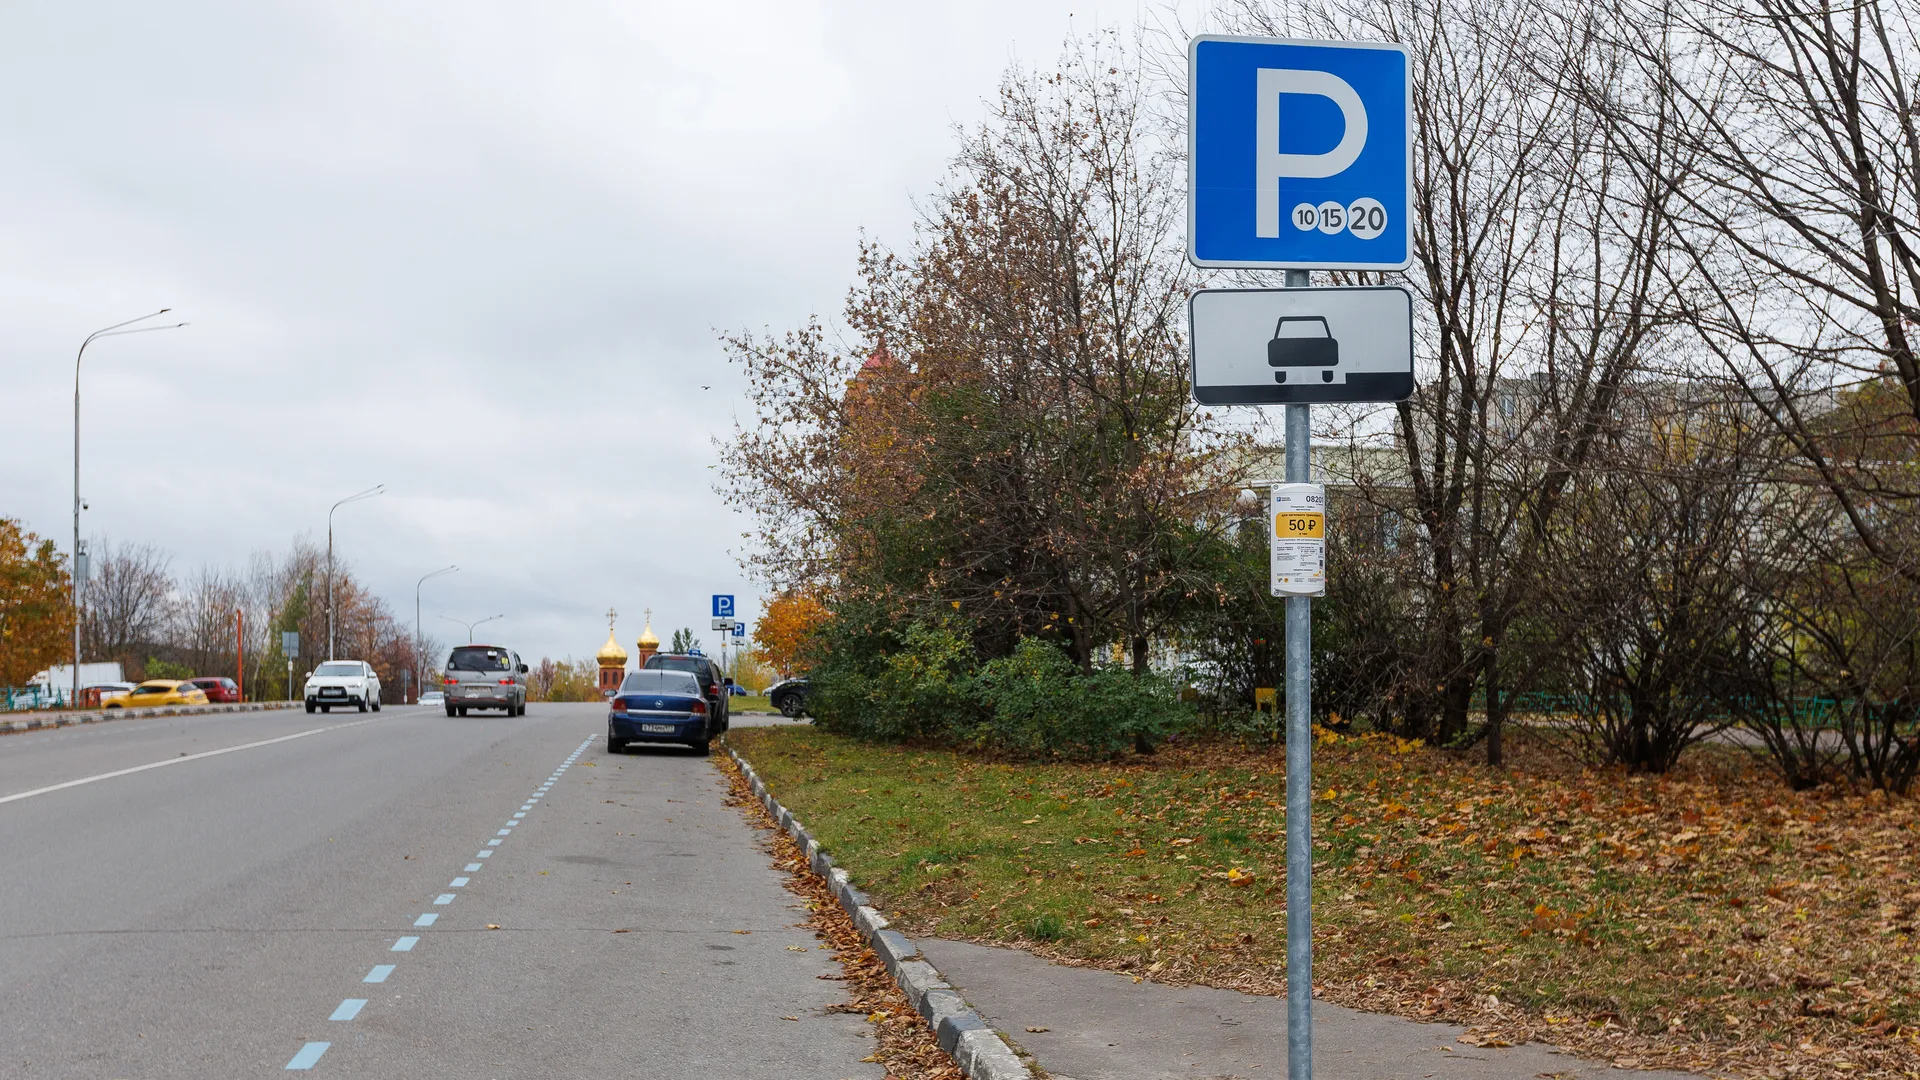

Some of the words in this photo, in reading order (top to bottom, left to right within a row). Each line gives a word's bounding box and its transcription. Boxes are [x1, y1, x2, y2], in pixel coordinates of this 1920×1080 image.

[1256, 68, 1369, 238] P
[1297, 209, 1315, 225] 10
[1321, 209, 1342, 227] 15
[1351, 206, 1384, 231] 20
[1289, 519, 1305, 531] 50
[718, 597, 731, 615] P
[734, 624, 742, 635] P
